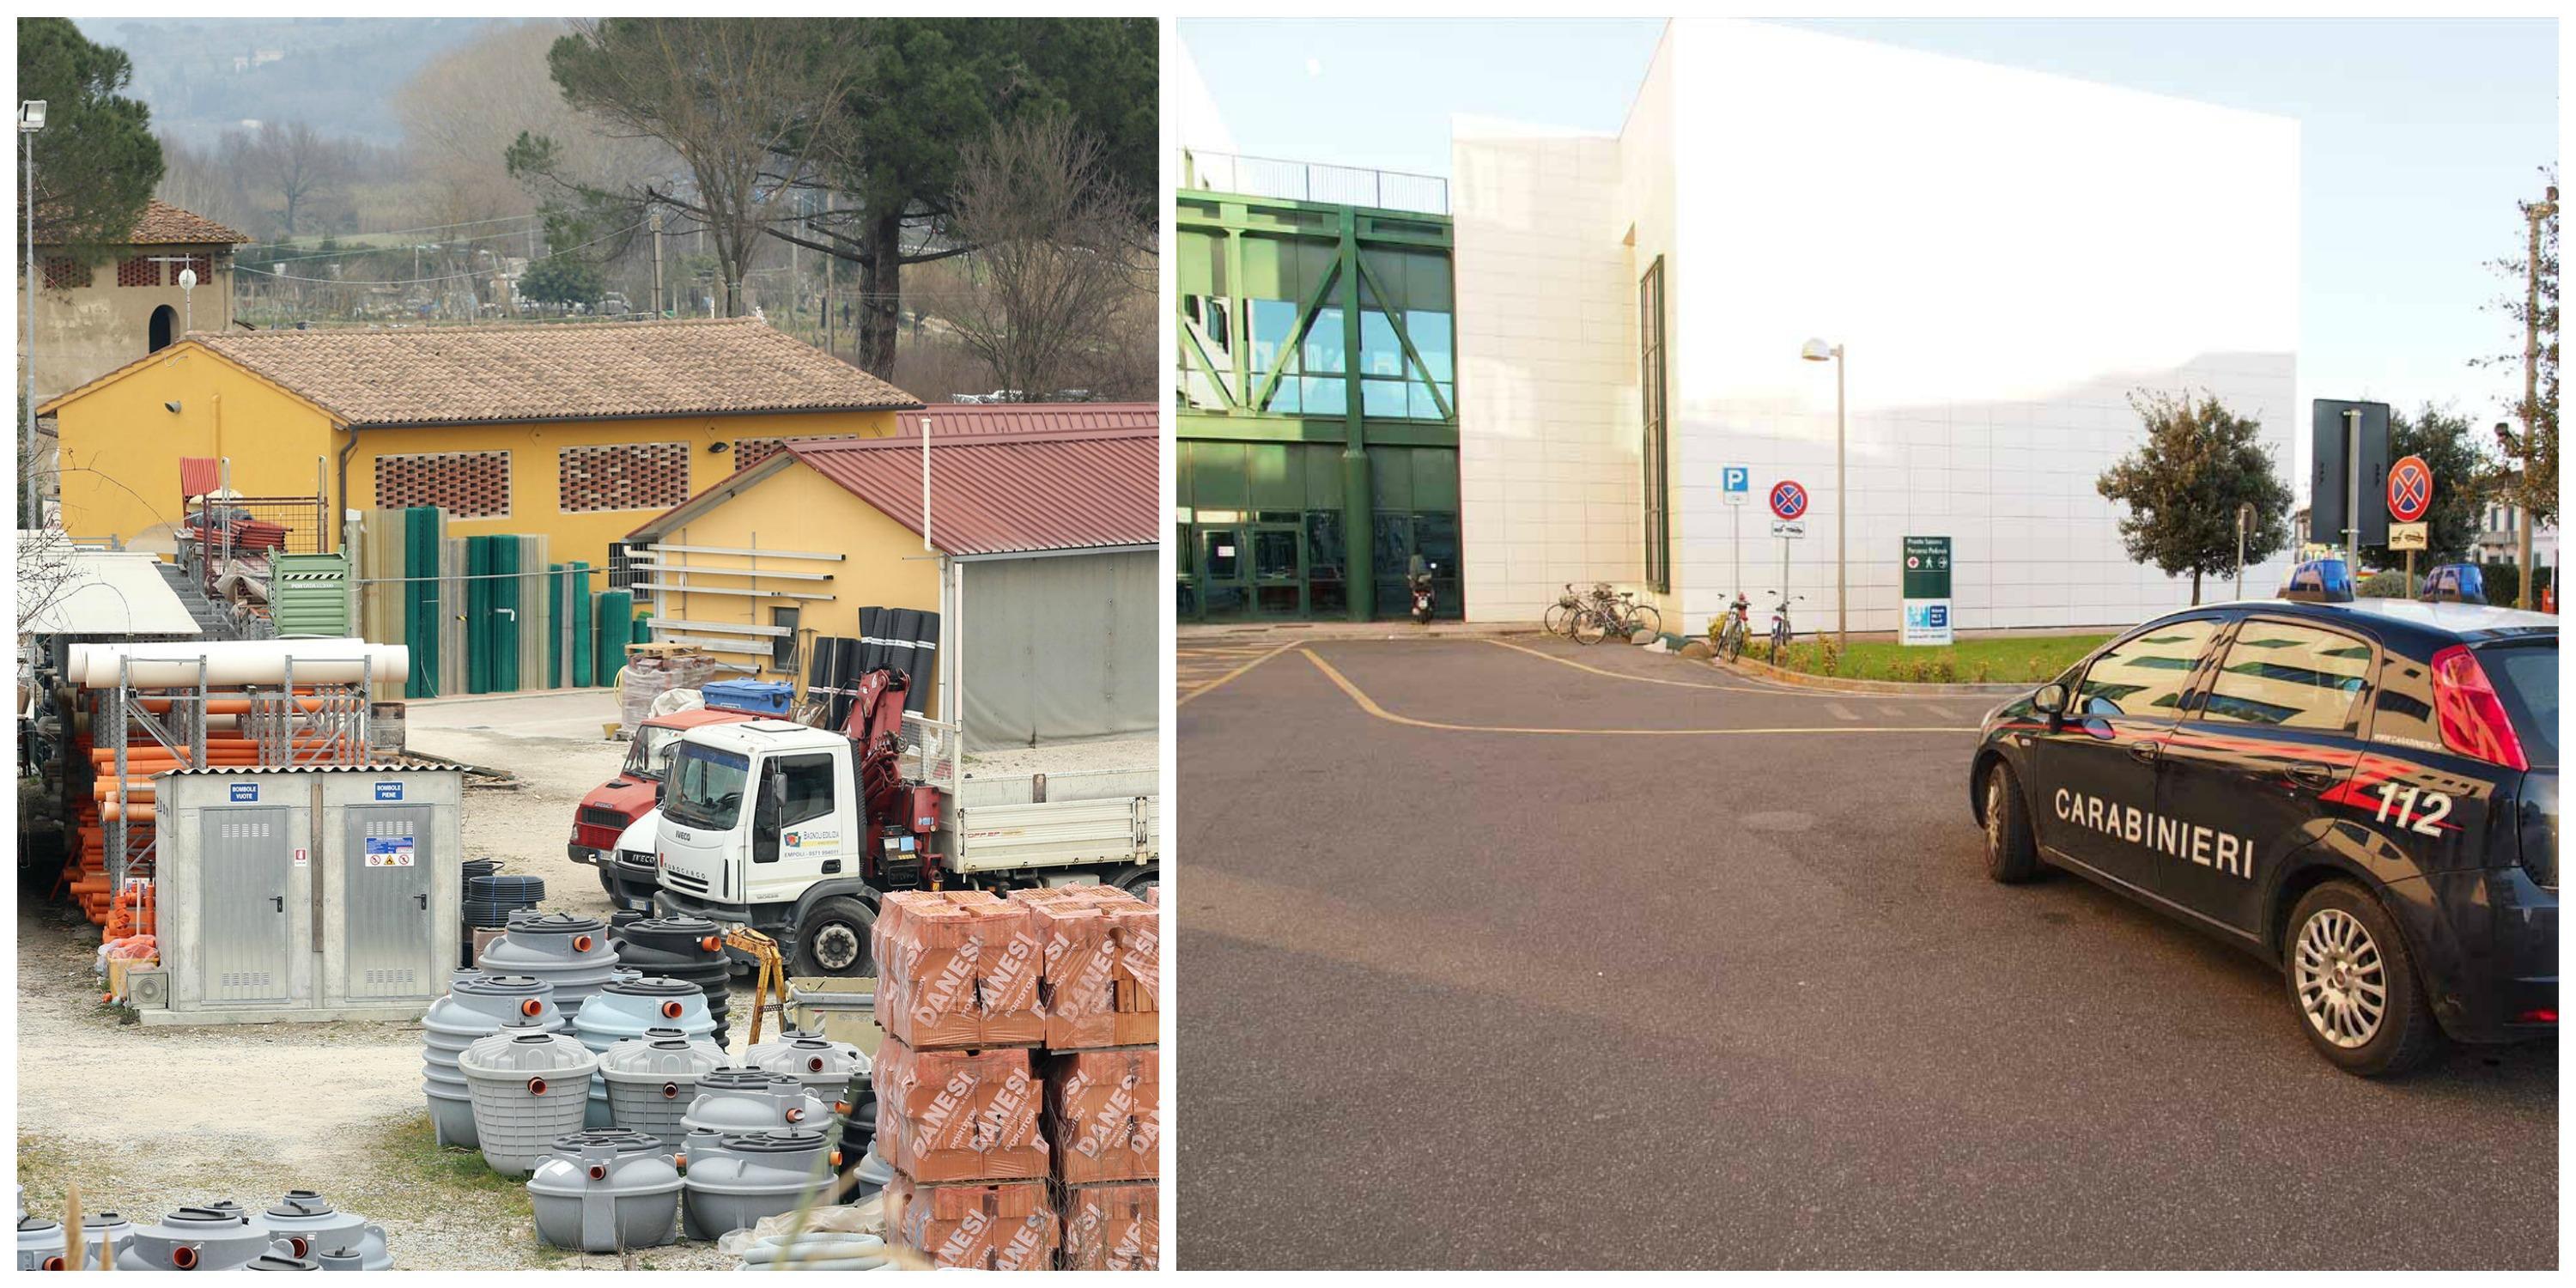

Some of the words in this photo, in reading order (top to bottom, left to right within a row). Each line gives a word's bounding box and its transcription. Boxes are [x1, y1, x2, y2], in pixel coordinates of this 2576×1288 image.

[1728, 470, 1744, 490] P
[2375, 781, 2452, 838] 112
[675, 829, 691, 841] IVECO
[2055, 787, 2254, 880] CARABINIERI
[632, 854, 655, 864] IVECO
[664, 862, 706, 879] EUROCARGO
[1005, 974, 1037, 1018] POROTON
[912, 1070, 977, 1159] DANESI
[968, 1066, 1030, 1153] DANESI
[1004, 1109, 1036, 1151] POROTON
